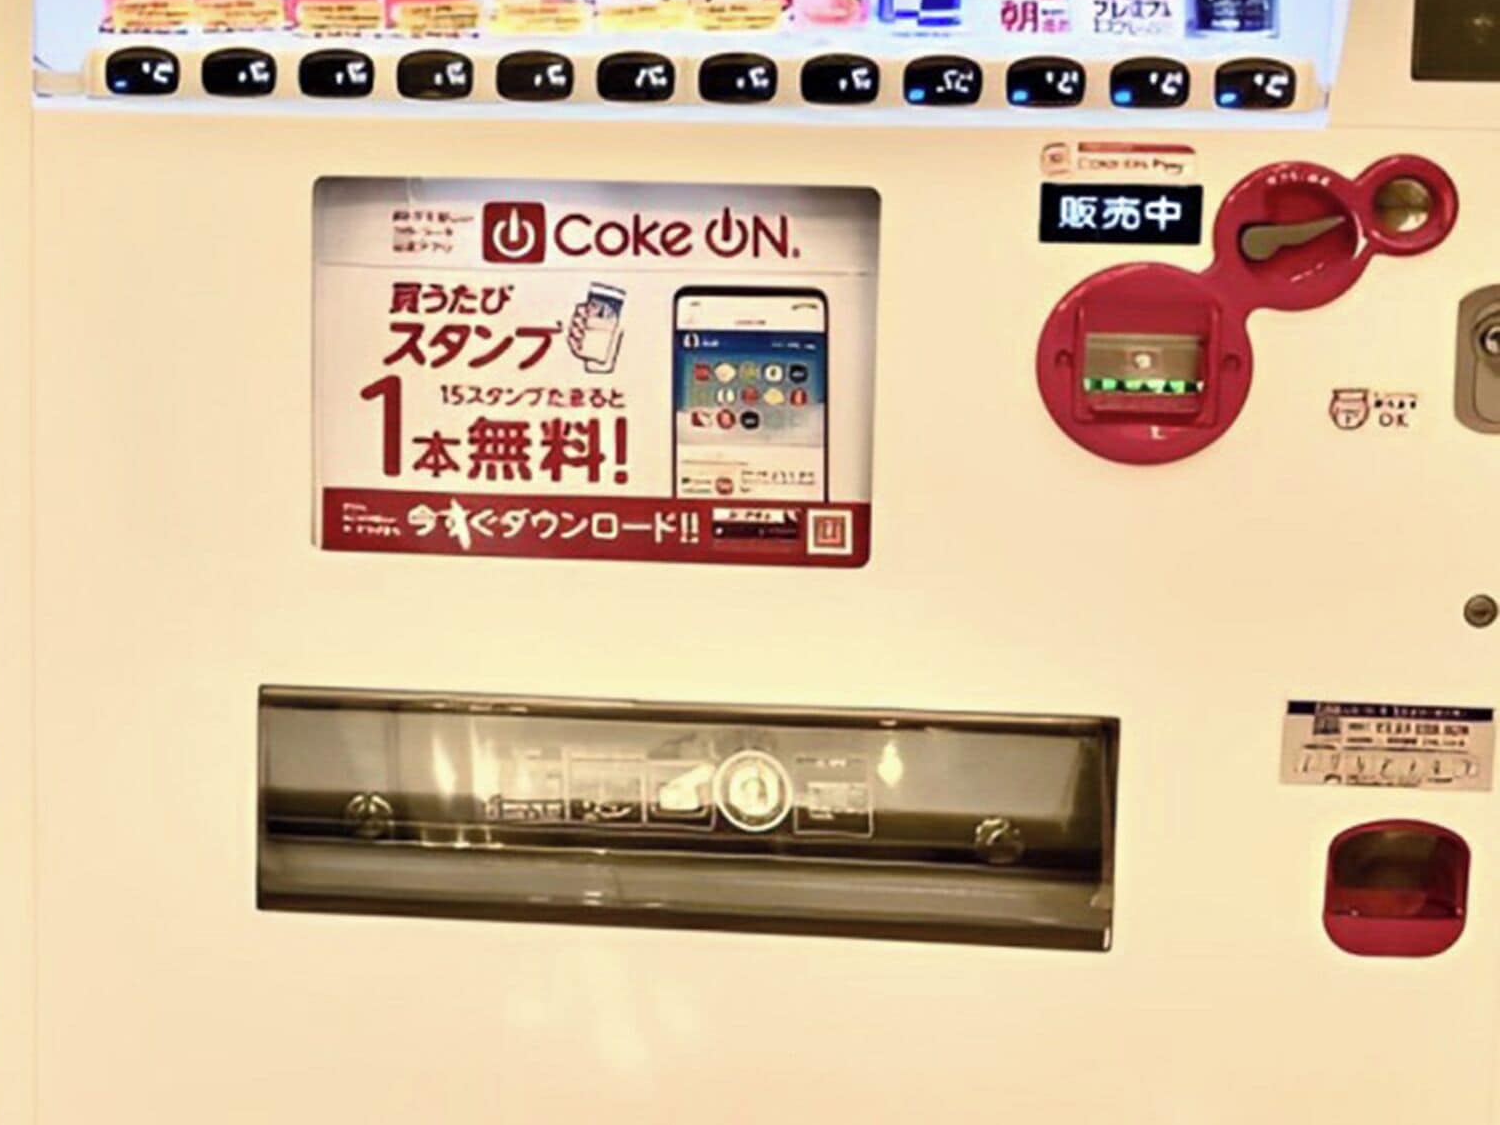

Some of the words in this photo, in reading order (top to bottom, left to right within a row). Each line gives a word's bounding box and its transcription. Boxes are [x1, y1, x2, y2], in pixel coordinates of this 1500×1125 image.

[1057, 194, 1183, 233] 販売中
[553, 212, 693, 259] Coke
[389, 282, 515, 316] 買うたび
[382, 320, 563, 371] スタンプ
